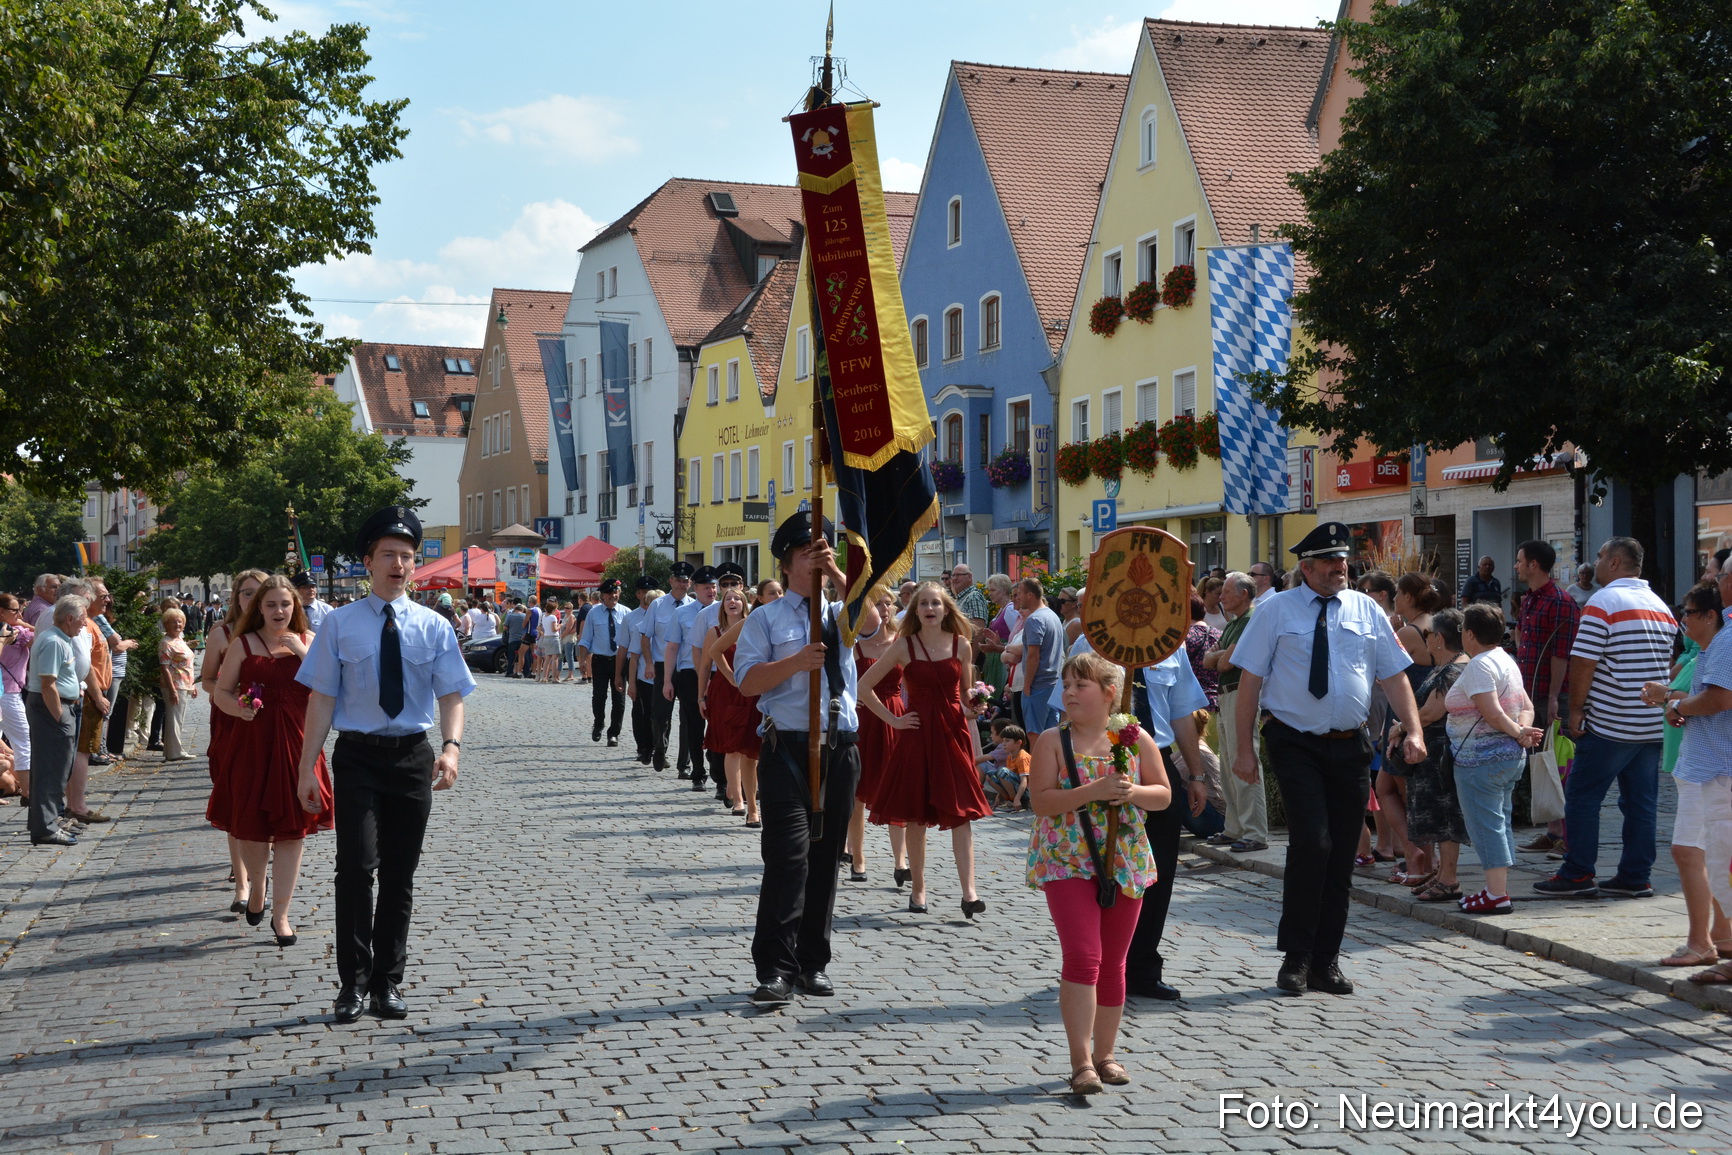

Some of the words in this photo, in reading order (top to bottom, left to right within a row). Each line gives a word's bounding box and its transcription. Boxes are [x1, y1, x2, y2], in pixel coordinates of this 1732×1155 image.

[822, 205, 843, 214] Zum
[825, 218, 848, 233] 125
[817, 249, 862, 263] Jubiläum
[829, 277, 867, 342] Patenverein
[840, 356, 872, 374] FFW
[836, 383, 882, 399] Seubers-
[851, 399, 874, 414] dorf
[718, 425, 740, 446] HOTEL
[853, 426, 881, 442] 2016
[1036, 442, 1049, 506] WITTL
[1377, 464, 1400, 475] DER
[1304, 450, 1312, 508] KINO
[1337, 474, 1351, 487] DER
[1098, 503, 1111, 528] P
[716, 524, 746, 538] Restaurant
[1130, 532, 1164, 553] FFW
[1087, 619, 1182, 663] Eichenhofen
